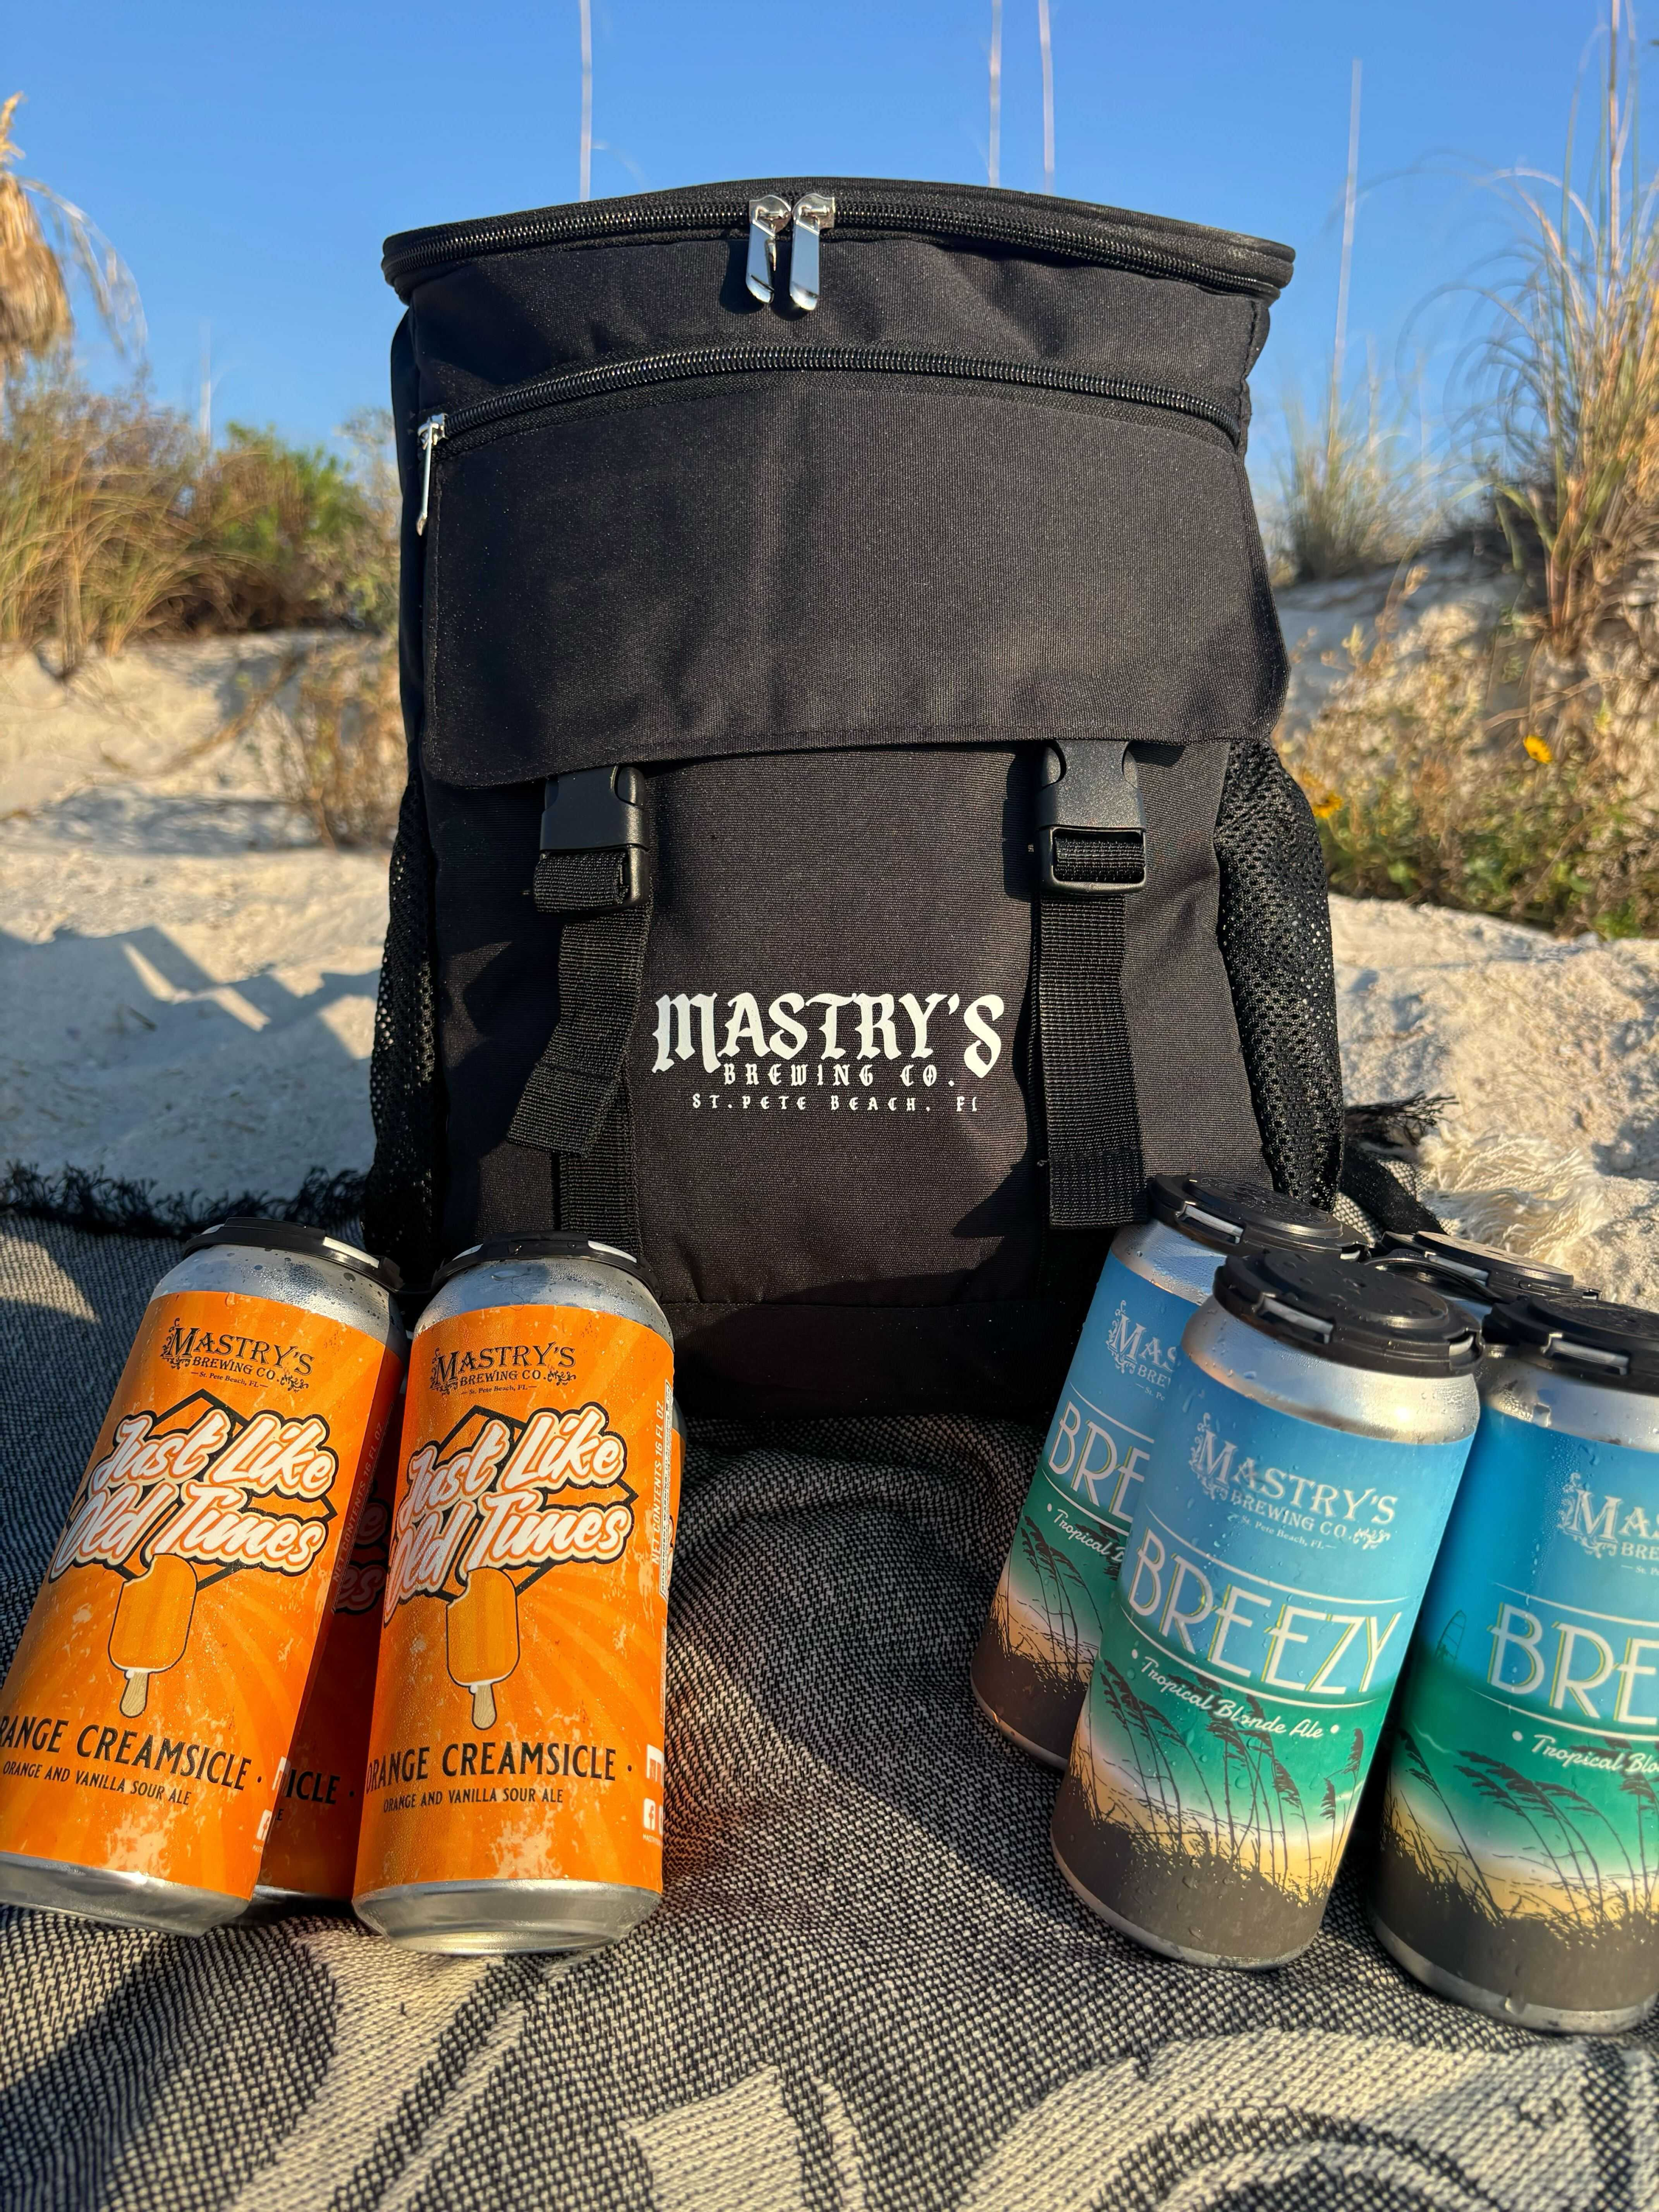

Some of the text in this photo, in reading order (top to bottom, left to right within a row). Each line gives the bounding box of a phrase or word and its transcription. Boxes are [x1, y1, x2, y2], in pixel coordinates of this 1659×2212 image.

[651, 992, 1005, 1079] MASTRY'S
[723, 1063, 956, 1088] BREWING CO.
[162, 1326, 316, 1377] MASTRY'S
[192, 1356, 279, 1382] BREWING CO.
[432, 1341, 576, 1388] MASTRY'S
[209, 1372, 223, 1380] Pete
[225, 1374, 247, 1386] Beach,
[460, 1370, 546, 1387] BREWING CO.
[90, 1410, 336, 1495] Just Like
[655, 1424, 664, 1439] FL
[655, 1441, 663, 1457] 16
[397, 1420, 507, 1531] Just
[500, 1406, 625, 1491] Like
[1194, 1430, 1399, 1525] MASTRY'S
[653, 1460, 663, 1533] CONTENTS
[1230, 1489, 1352, 1541] BREWING CO.
[53, 1482, 177, 1577] Old
[148, 1481, 327, 1568] Times
[465, 1487, 630, 1570] Times
[652, 1539, 661, 1565] NET
[1054, 1509, 1113, 1555] Tropical
[1254, 1521, 1275, 1534] Pete
[1276, 1527, 1308, 1547] Beach,
[1310, 1539, 1324, 1549] FL
[1129, 1527, 1402, 1694] BREEZY
[1141, 1656, 1324, 1739] Tropical Blonde Ale
[77, 1723, 252, 1792] CREAMSICLE
[365, 1741, 617, 1795] ORANGE CREAMSICLE
[1531, 1733, 1625, 1770] Tropical
[3, 1760, 192, 1806] ORANGE AND VANILLA SOUR ALE
[383, 1787, 563, 1813] ORANGE AND VANILLA SOUR ALE
